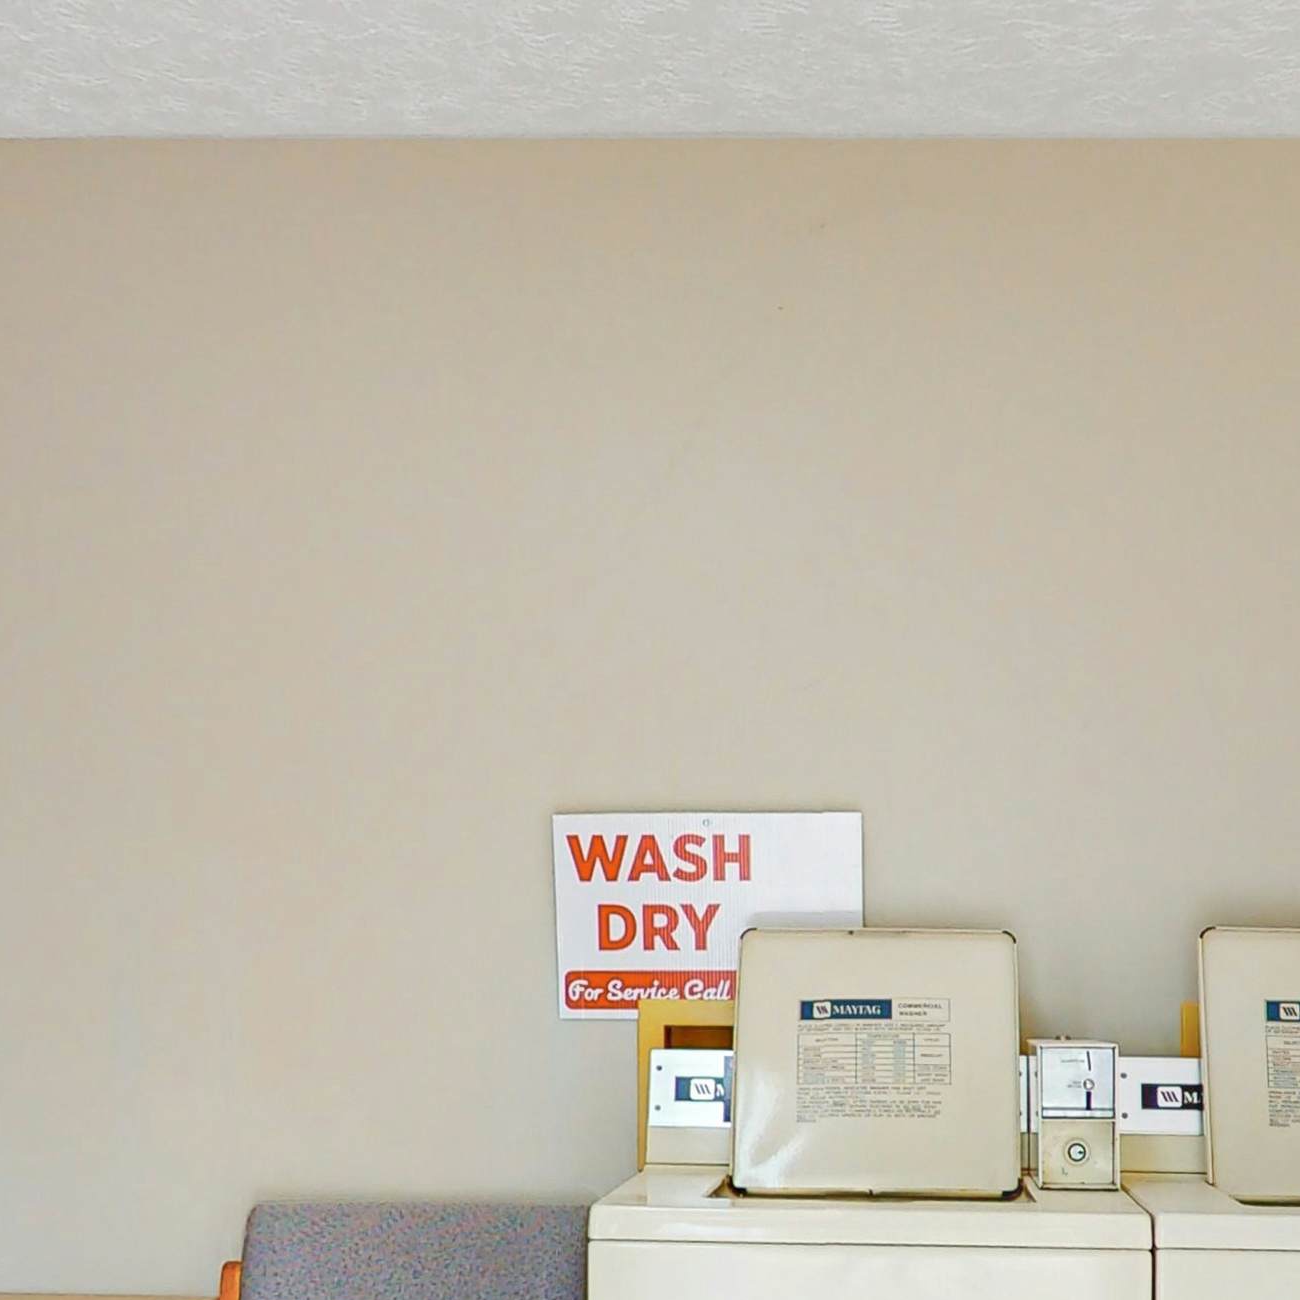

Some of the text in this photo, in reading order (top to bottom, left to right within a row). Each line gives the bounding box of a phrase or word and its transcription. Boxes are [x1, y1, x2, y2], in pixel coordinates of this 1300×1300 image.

[566, 833, 751, 882] WASH
[597, 904, 721, 951] DRY
[568, 979, 732, 1001] For Service Call
[832, 1005, 882, 1015] MAYTAG
